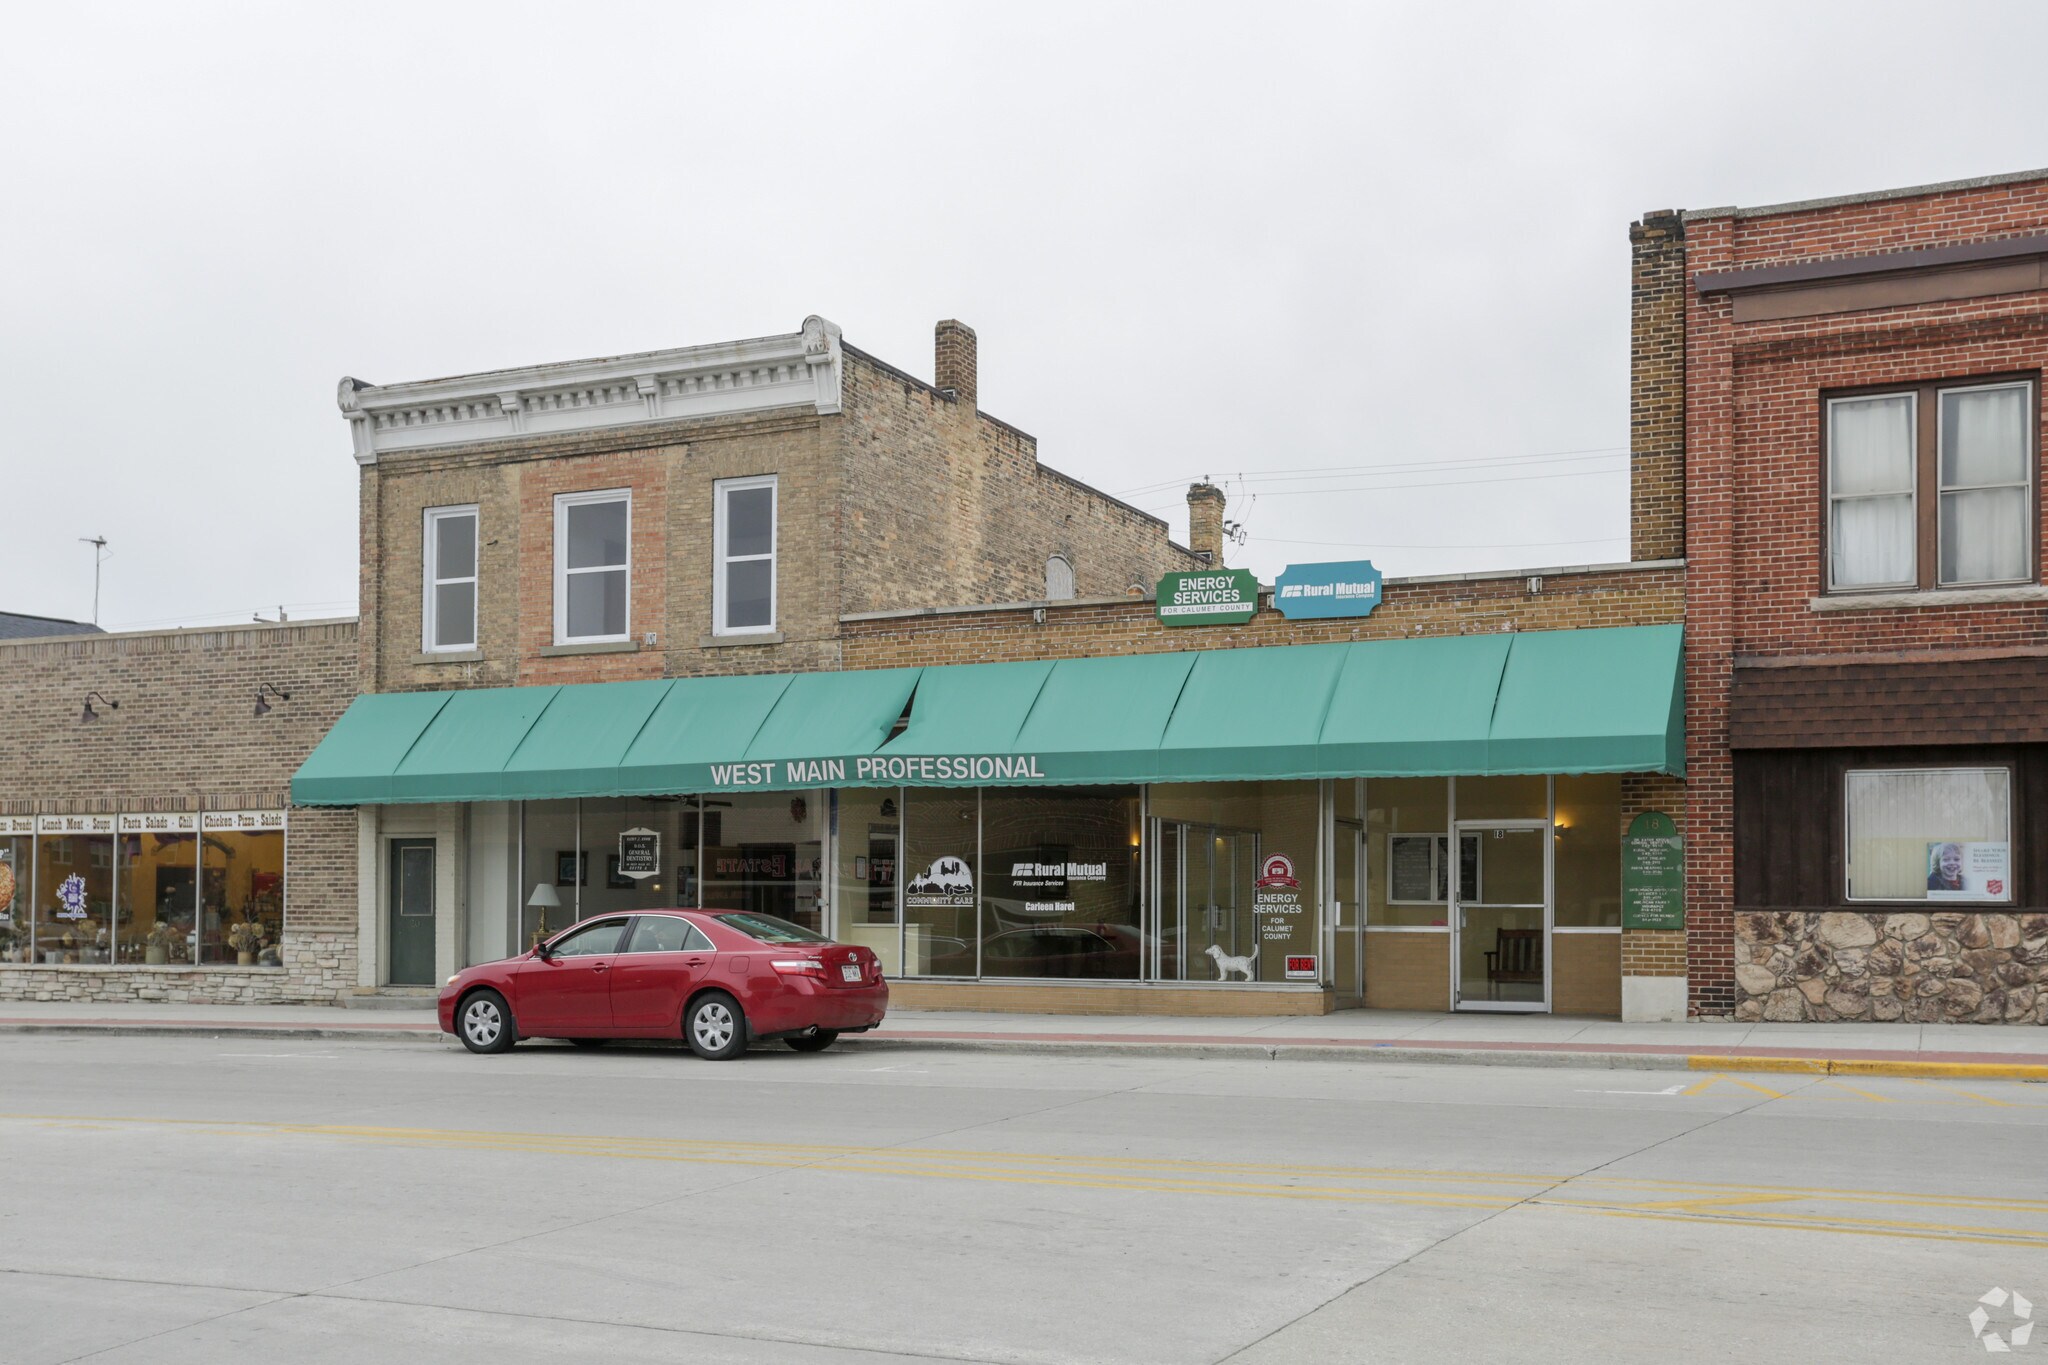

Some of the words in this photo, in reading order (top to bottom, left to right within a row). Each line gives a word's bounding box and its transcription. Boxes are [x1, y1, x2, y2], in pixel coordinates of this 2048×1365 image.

[1179, 575, 1235, 591] ENERGY
[1304, 583, 1334, 597] Rural
[1336, 581, 1375, 595] Mutual
[1173, 589, 1240, 605] SERVICES
[1163, 607, 1178, 615] FOR
[1181, 605, 1217, 613] CALUMET
[1220, 603, 1250, 612] COUNTY
[710, 762, 775, 785] WEST
[787, 759, 845, 783] MAIN
[856, 756, 1045, 780] PROFESSIONAL
[12, 819, 32, 831] Breads
[42, 818, 62, 830] Lunch
[66, 818, 84, 830] Meat
[92, 817, 111, 832] Soups
[123, 817, 141, 829] Pasta
[145, 816, 168, 828] Salads
[178, 815, 194, 828] Chili
[204, 815, 233, 828] Chicken
[238, 814, 255, 827] Pizza
[261, 813, 282, 826] Salads
[1646, 818, 1659, 830] 18
[1495, 830, 1503, 838] 18
[1035, 863, 1065, 876] Rural
[1067, 862, 1107, 876] Mutual
[907, 897, 952, 905] COMMUNITY
[954, 897, 974, 905] CARE
[1257, 893, 1298, 903] ENERGY
[1025, 902, 1054, 912] Carleen
[1054, 902, 1075, 912] Harel
[1253, 904, 1302, 914] SERVICES
